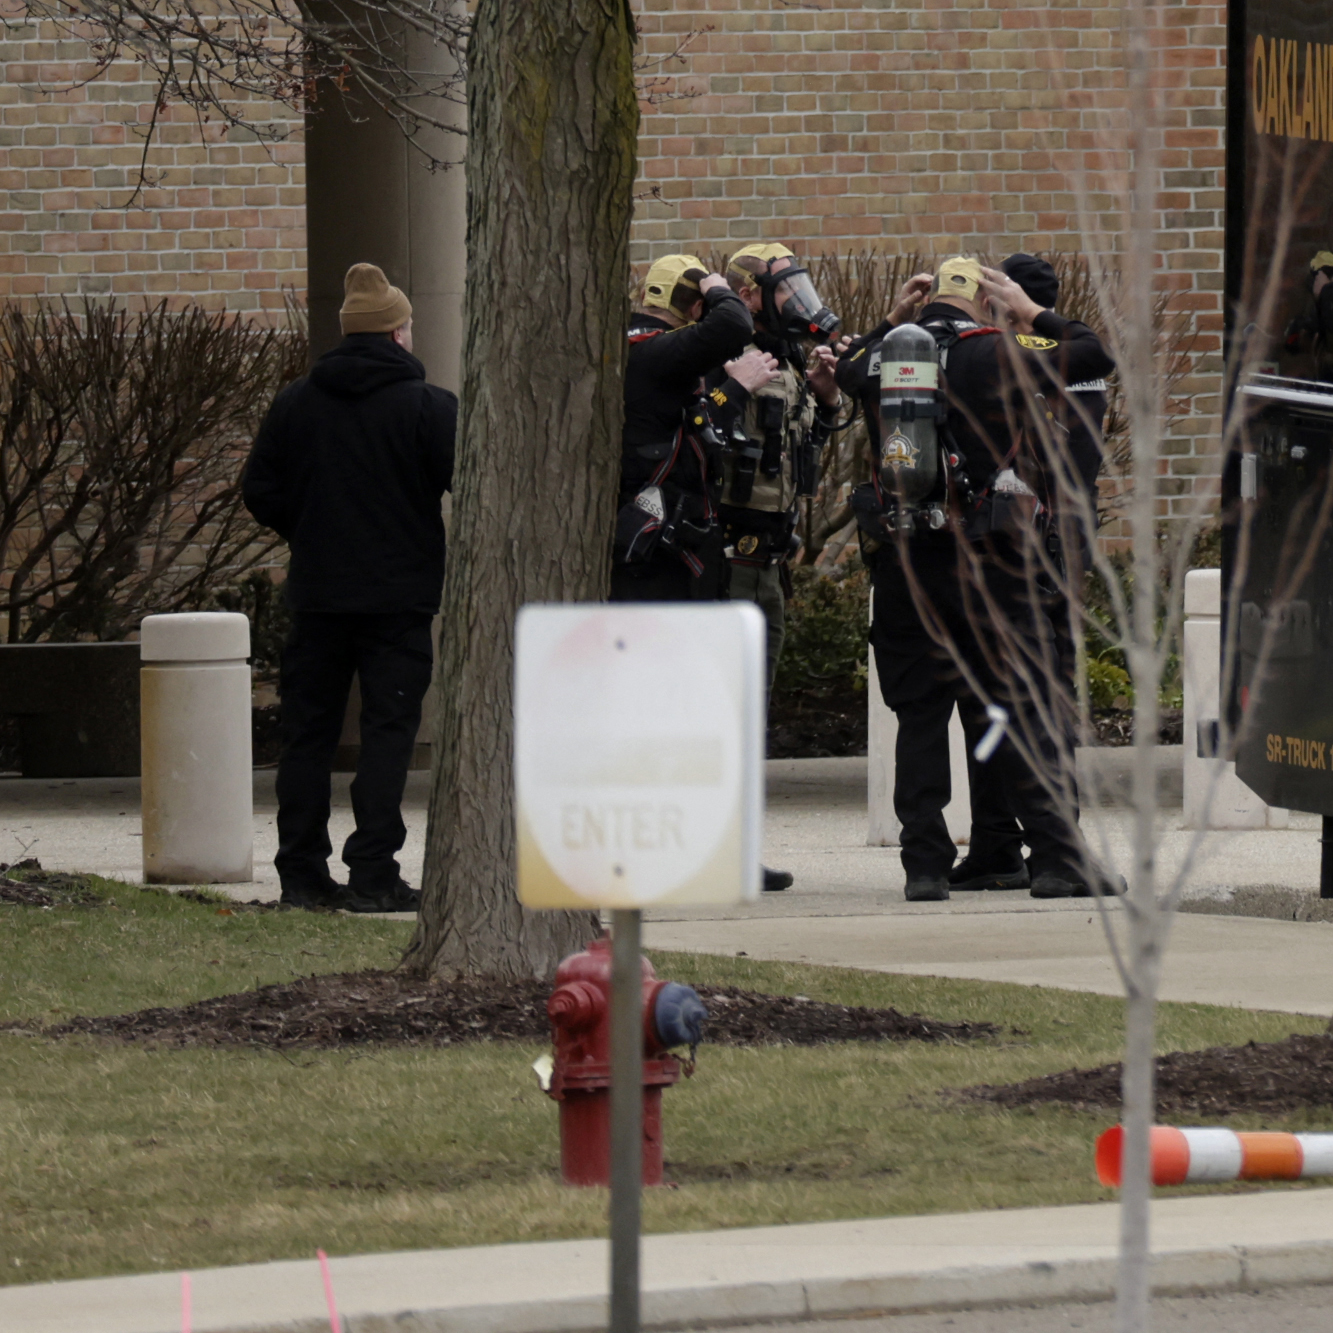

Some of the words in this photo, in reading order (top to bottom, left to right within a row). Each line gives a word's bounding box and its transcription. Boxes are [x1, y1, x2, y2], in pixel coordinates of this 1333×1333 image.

[898, 366, 915, 376] 3M
[1266, 733, 1326, 770] SR-TRUCK
[561, 803, 685, 851] ENTER
